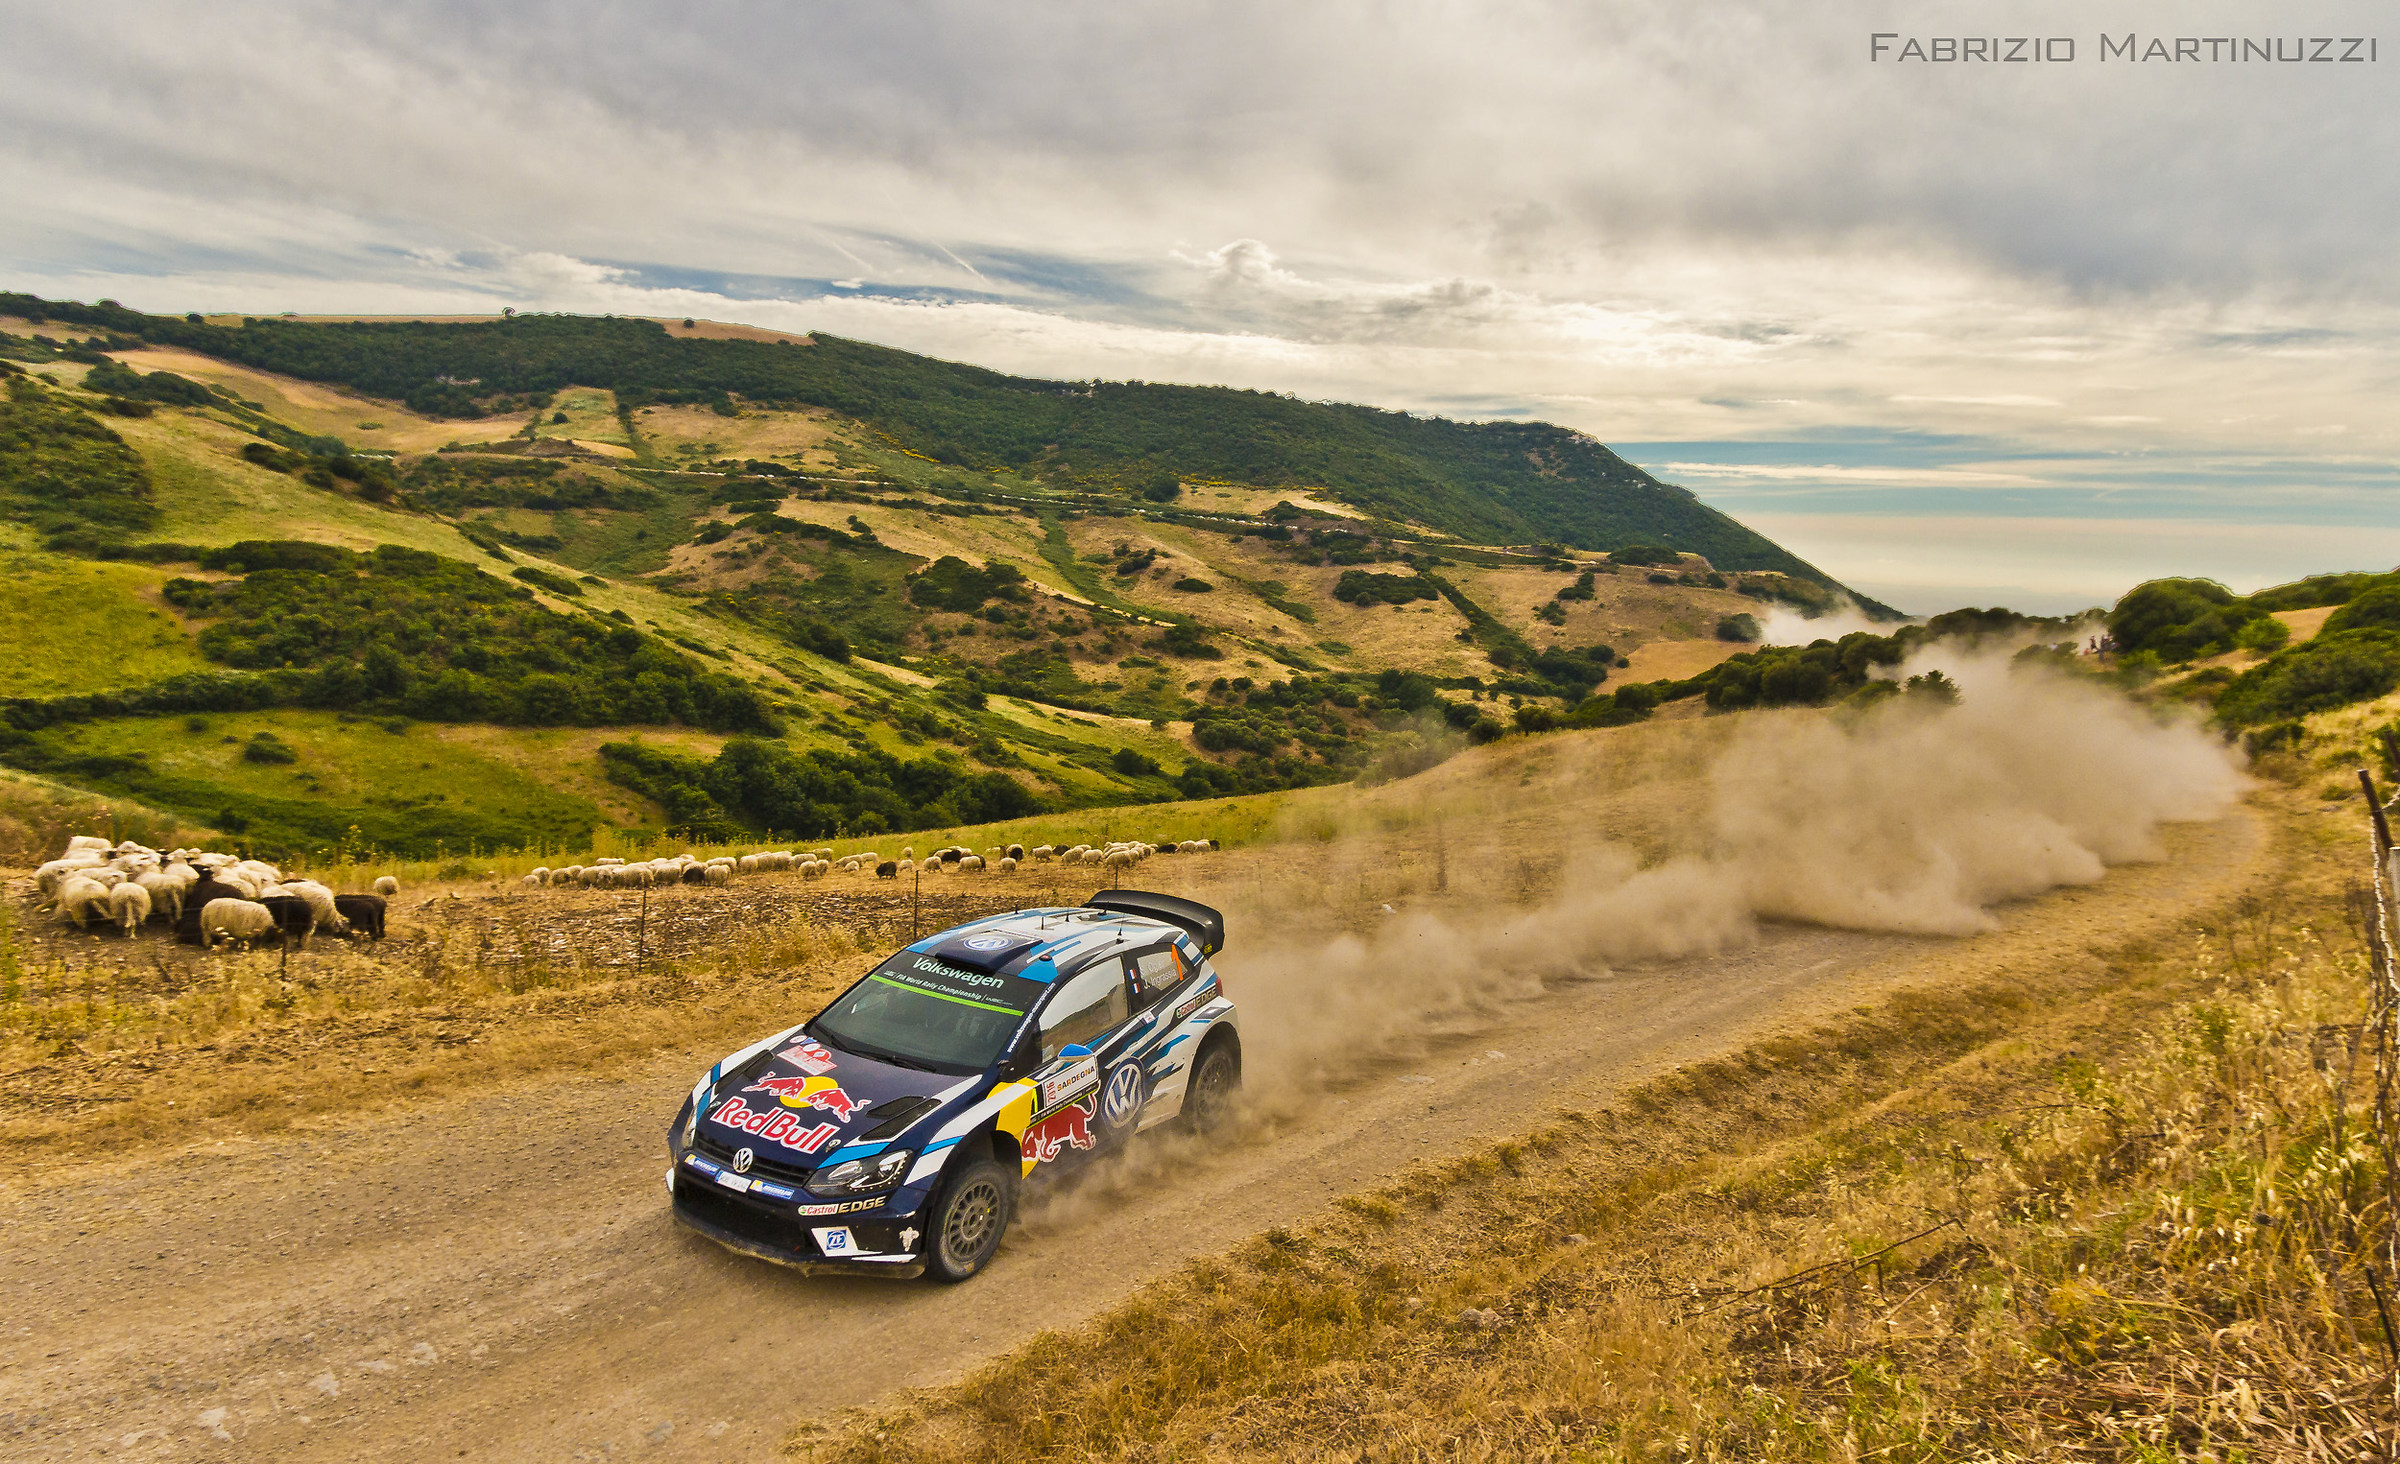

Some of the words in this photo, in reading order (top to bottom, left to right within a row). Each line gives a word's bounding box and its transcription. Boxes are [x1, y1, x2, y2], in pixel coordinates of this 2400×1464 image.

[913, 957, 1004, 989] Volkswagen
[905, 975, 922, 986] World
[922, 980, 938, 989] Rally
[937, 984, 982, 1000] Championship
[1195, 988, 1217, 1007] EDGE
[1057, 1066, 1095, 1092] SARDEGNA
[1046, 1081, 1056, 1102] 2016
[711, 1097, 784, 1134] Red
[760, 1111, 840, 1154] Bull
[806, 1206, 836, 1215] Castrol
[838, 1196, 887, 1214] EDGE
[830, 1233, 845, 1248] ZF
